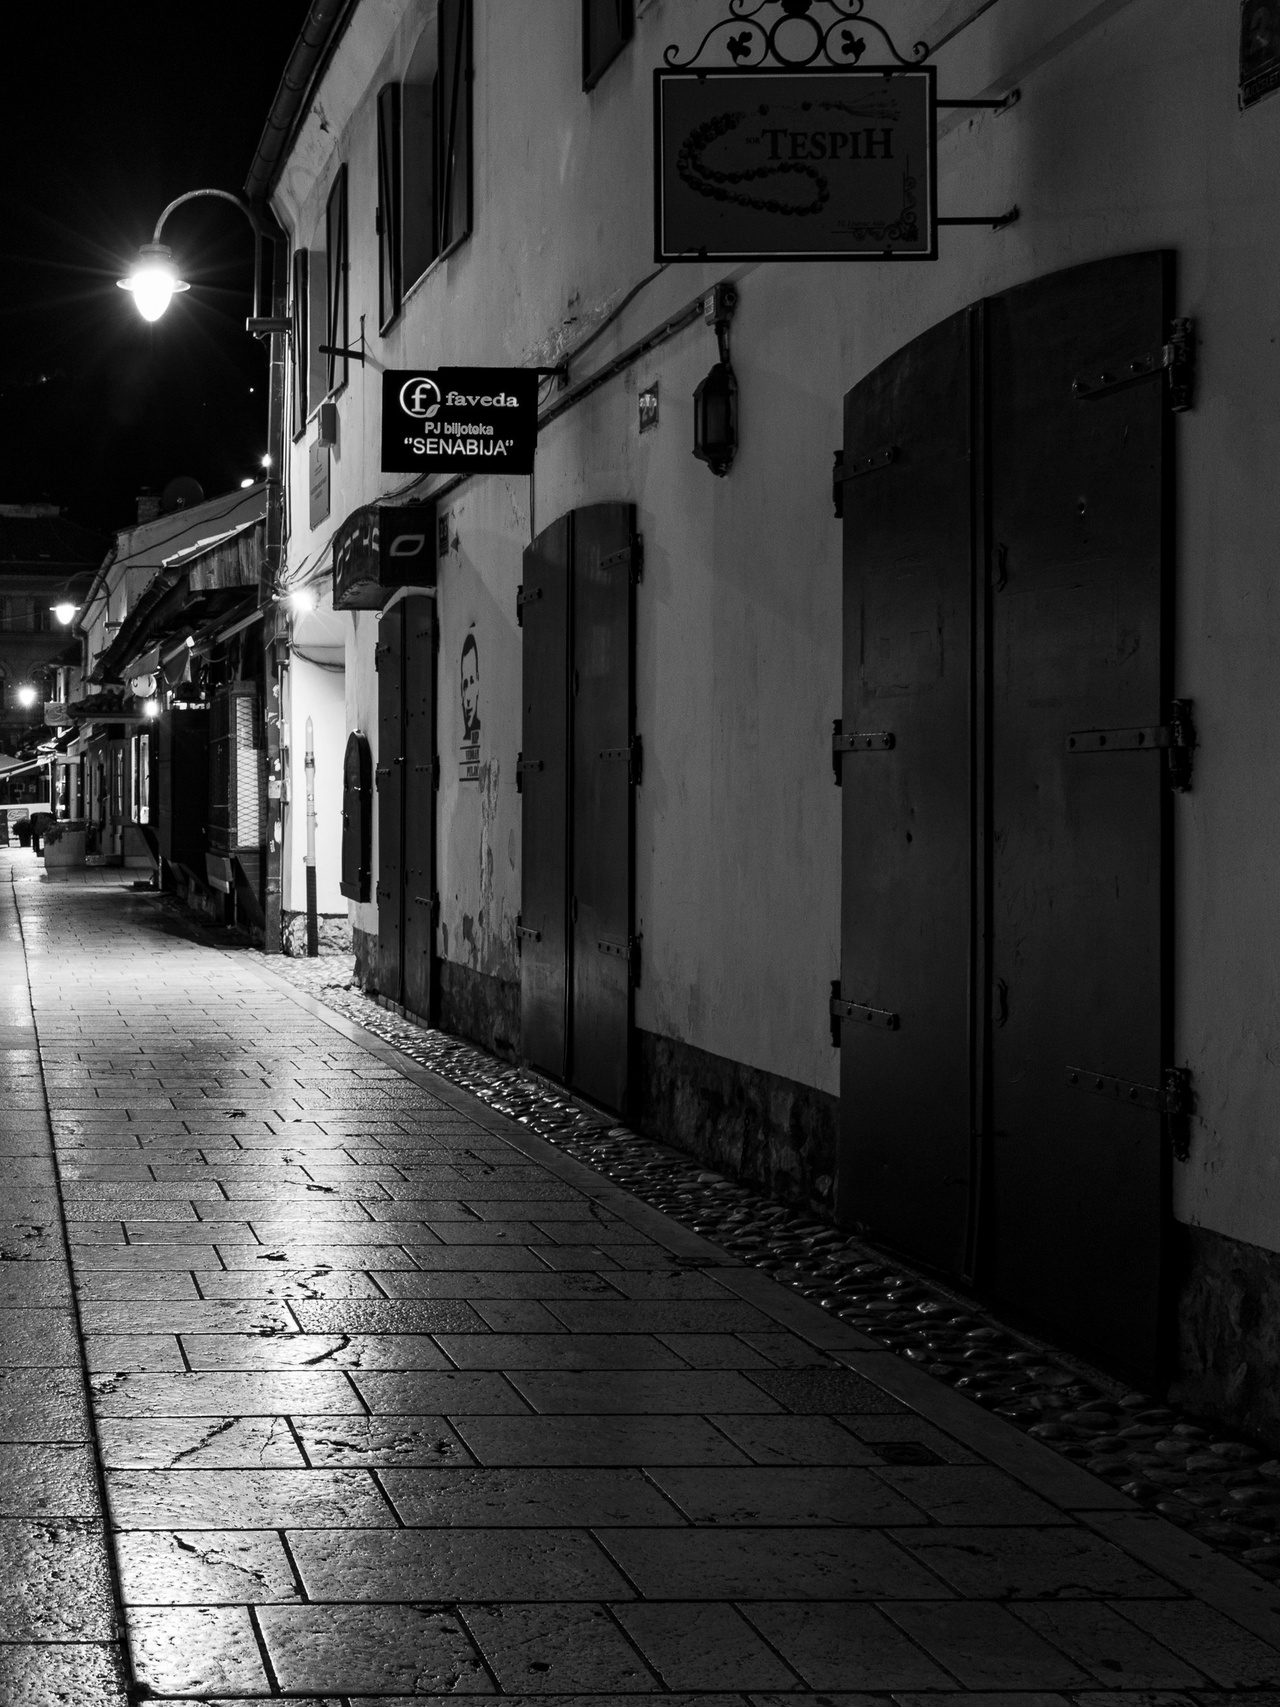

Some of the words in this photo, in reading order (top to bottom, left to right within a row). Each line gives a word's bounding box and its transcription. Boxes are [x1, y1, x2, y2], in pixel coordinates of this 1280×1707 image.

[761, 128, 894, 160] TESPIH
[445, 391, 519, 408] faveda
[424, 421, 441, 434] PJ
[444, 422, 494, 437] biljoteka
